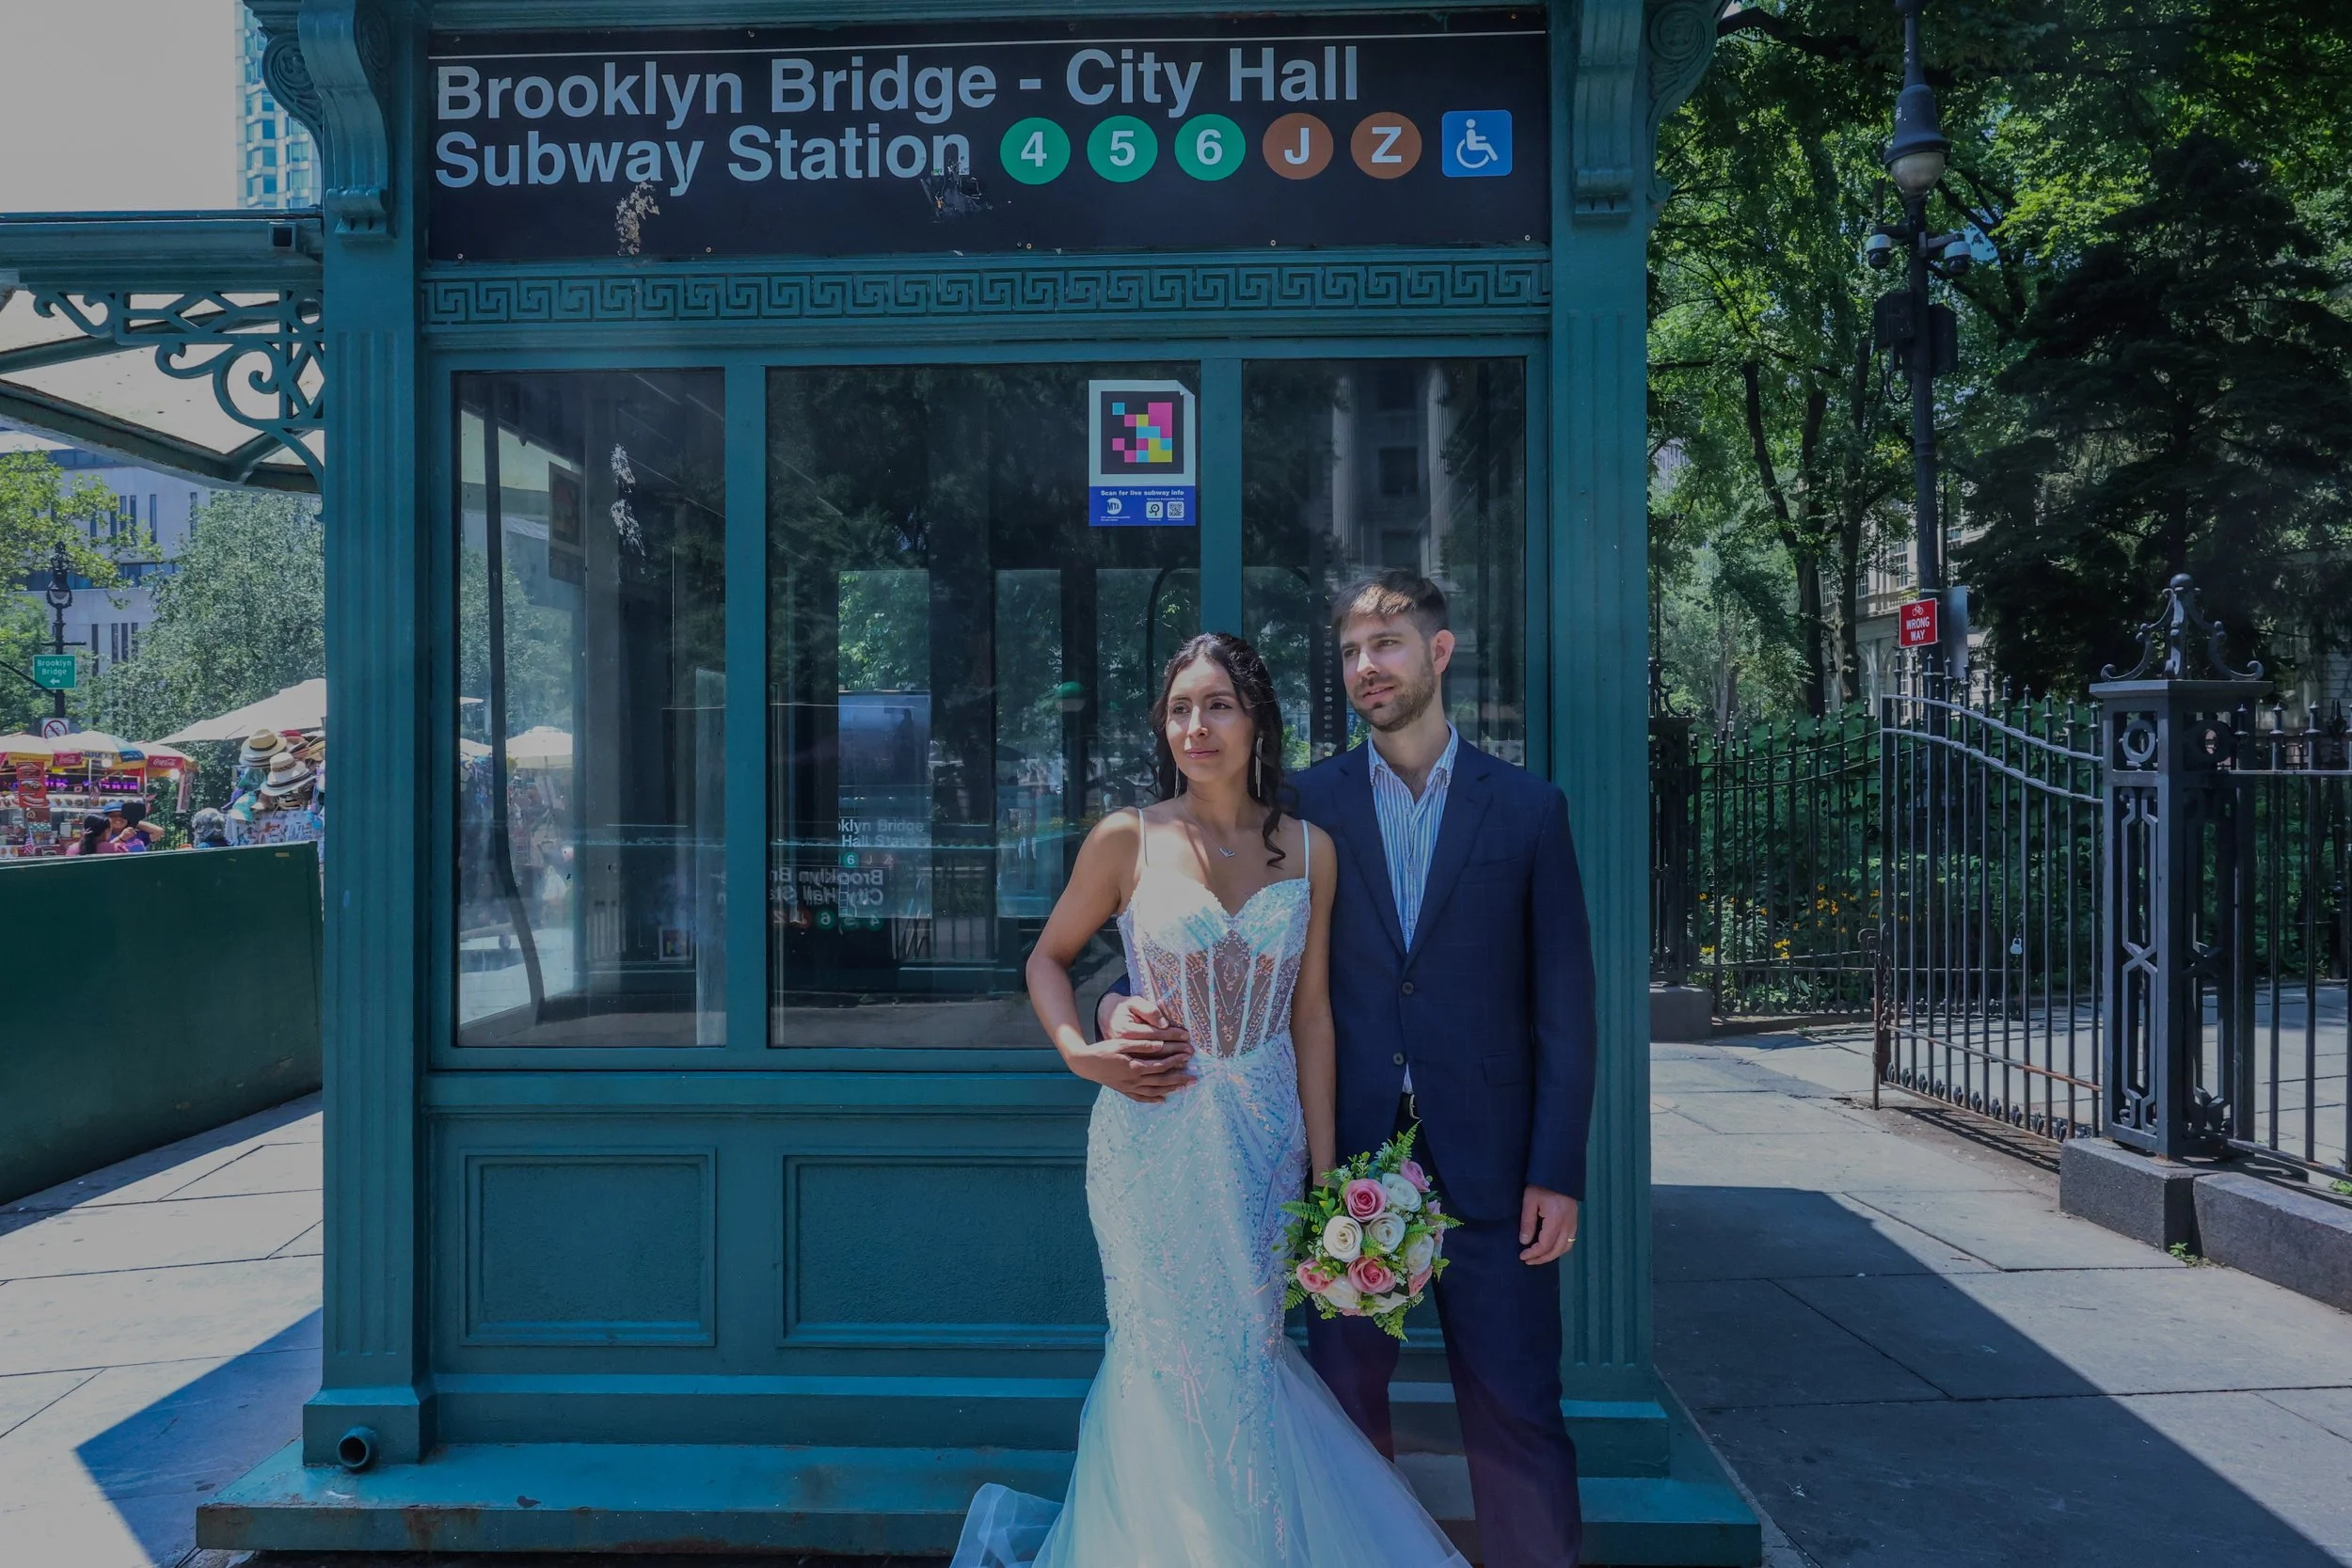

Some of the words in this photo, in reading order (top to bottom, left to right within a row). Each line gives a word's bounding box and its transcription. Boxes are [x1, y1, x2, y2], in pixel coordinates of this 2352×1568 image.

[437, 61, 742, 131] Brooklyn
[771, 55, 997, 124] Bridge
[1066, 48, 1203, 119] City
[1230, 45, 1358, 103] Hall
[436, 130, 704, 197] Subway
[727, 122, 970, 182] Station
[1020, 131, 1047, 167] 4
[1109, 130, 1136, 166] 5
[1197, 128, 1223, 166] 6
[1284, 127, 1310, 165] J
[1371, 126, 1402, 164] Z
[1906, 616, 1931, 631] WRONG
[1910, 629, 1926, 641] WAY
[37, 658, 72, 668] Brooklyn
[41, 667, 68, 676] Bridge
[877, 818, 925, 834] Bridge
[841, 834, 869, 847] Hall
[846, 854, 855, 865] 6
